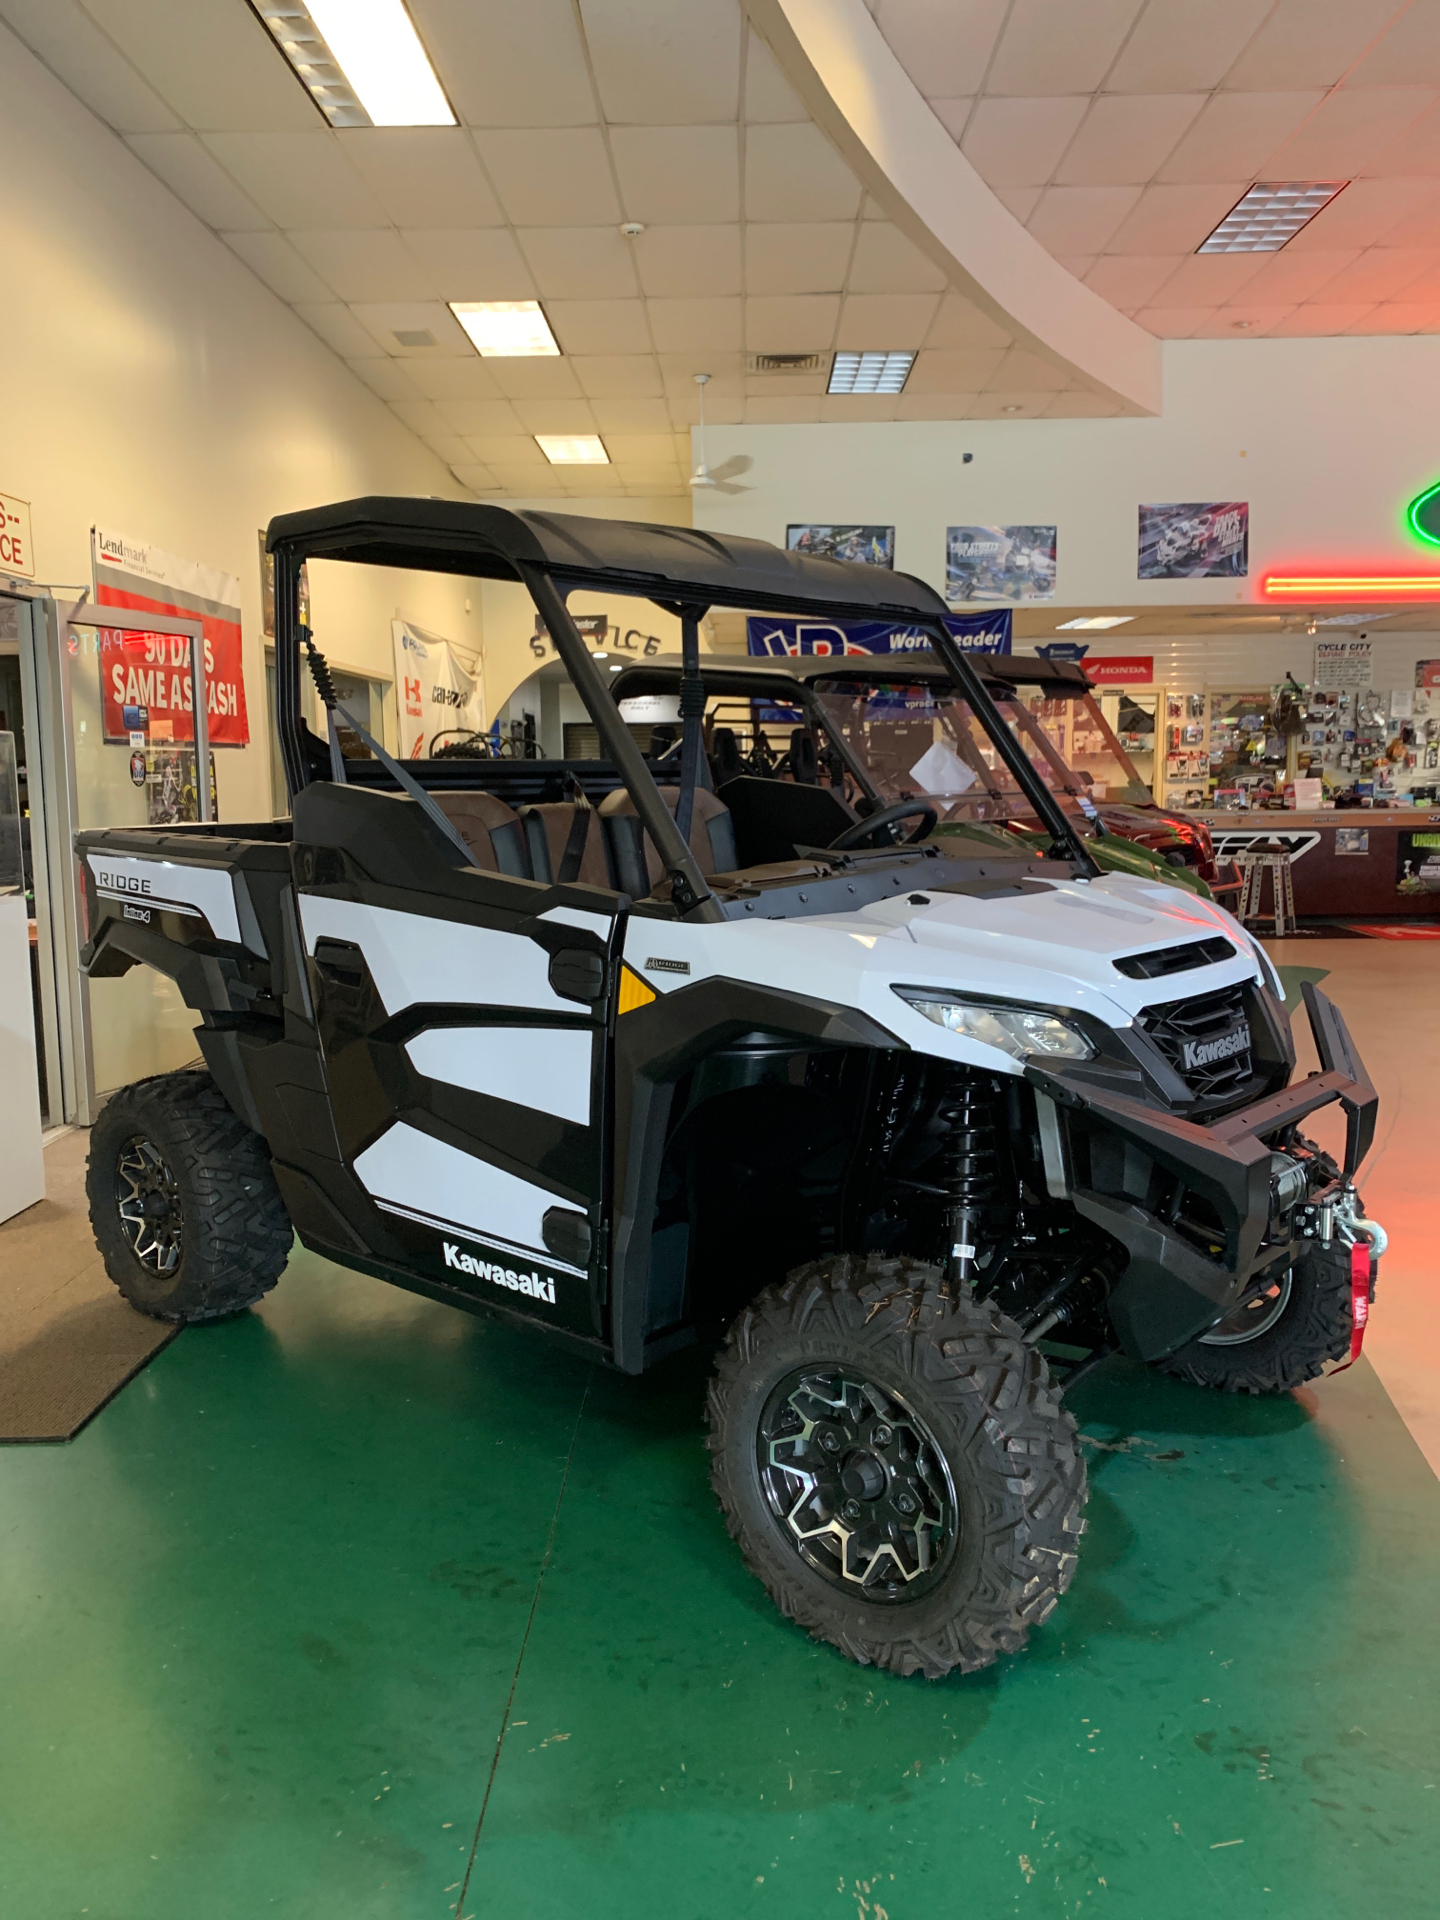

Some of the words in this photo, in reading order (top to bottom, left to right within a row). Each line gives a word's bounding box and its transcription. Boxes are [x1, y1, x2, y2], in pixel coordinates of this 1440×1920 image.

[99, 532, 147, 564] Lendmark
[889, 634, 932, 649] Worl
[953, 630, 1003, 647] eader
[1317, 643, 1347, 651] CYCLE
[1349, 642, 1372, 651] CITY
[1100, 665, 1148, 675] HONDA
[112, 663, 168, 709] SAME
[170, 674, 193, 712] AS
[205, 680, 238, 716] ASH
[100, 871, 152, 894] RIDGE
[1183, 1024, 1251, 1070] Kawasaki
[443, 1241, 556, 1304] Kawasaki
[1354, 1295, 1367, 1330] WARN
